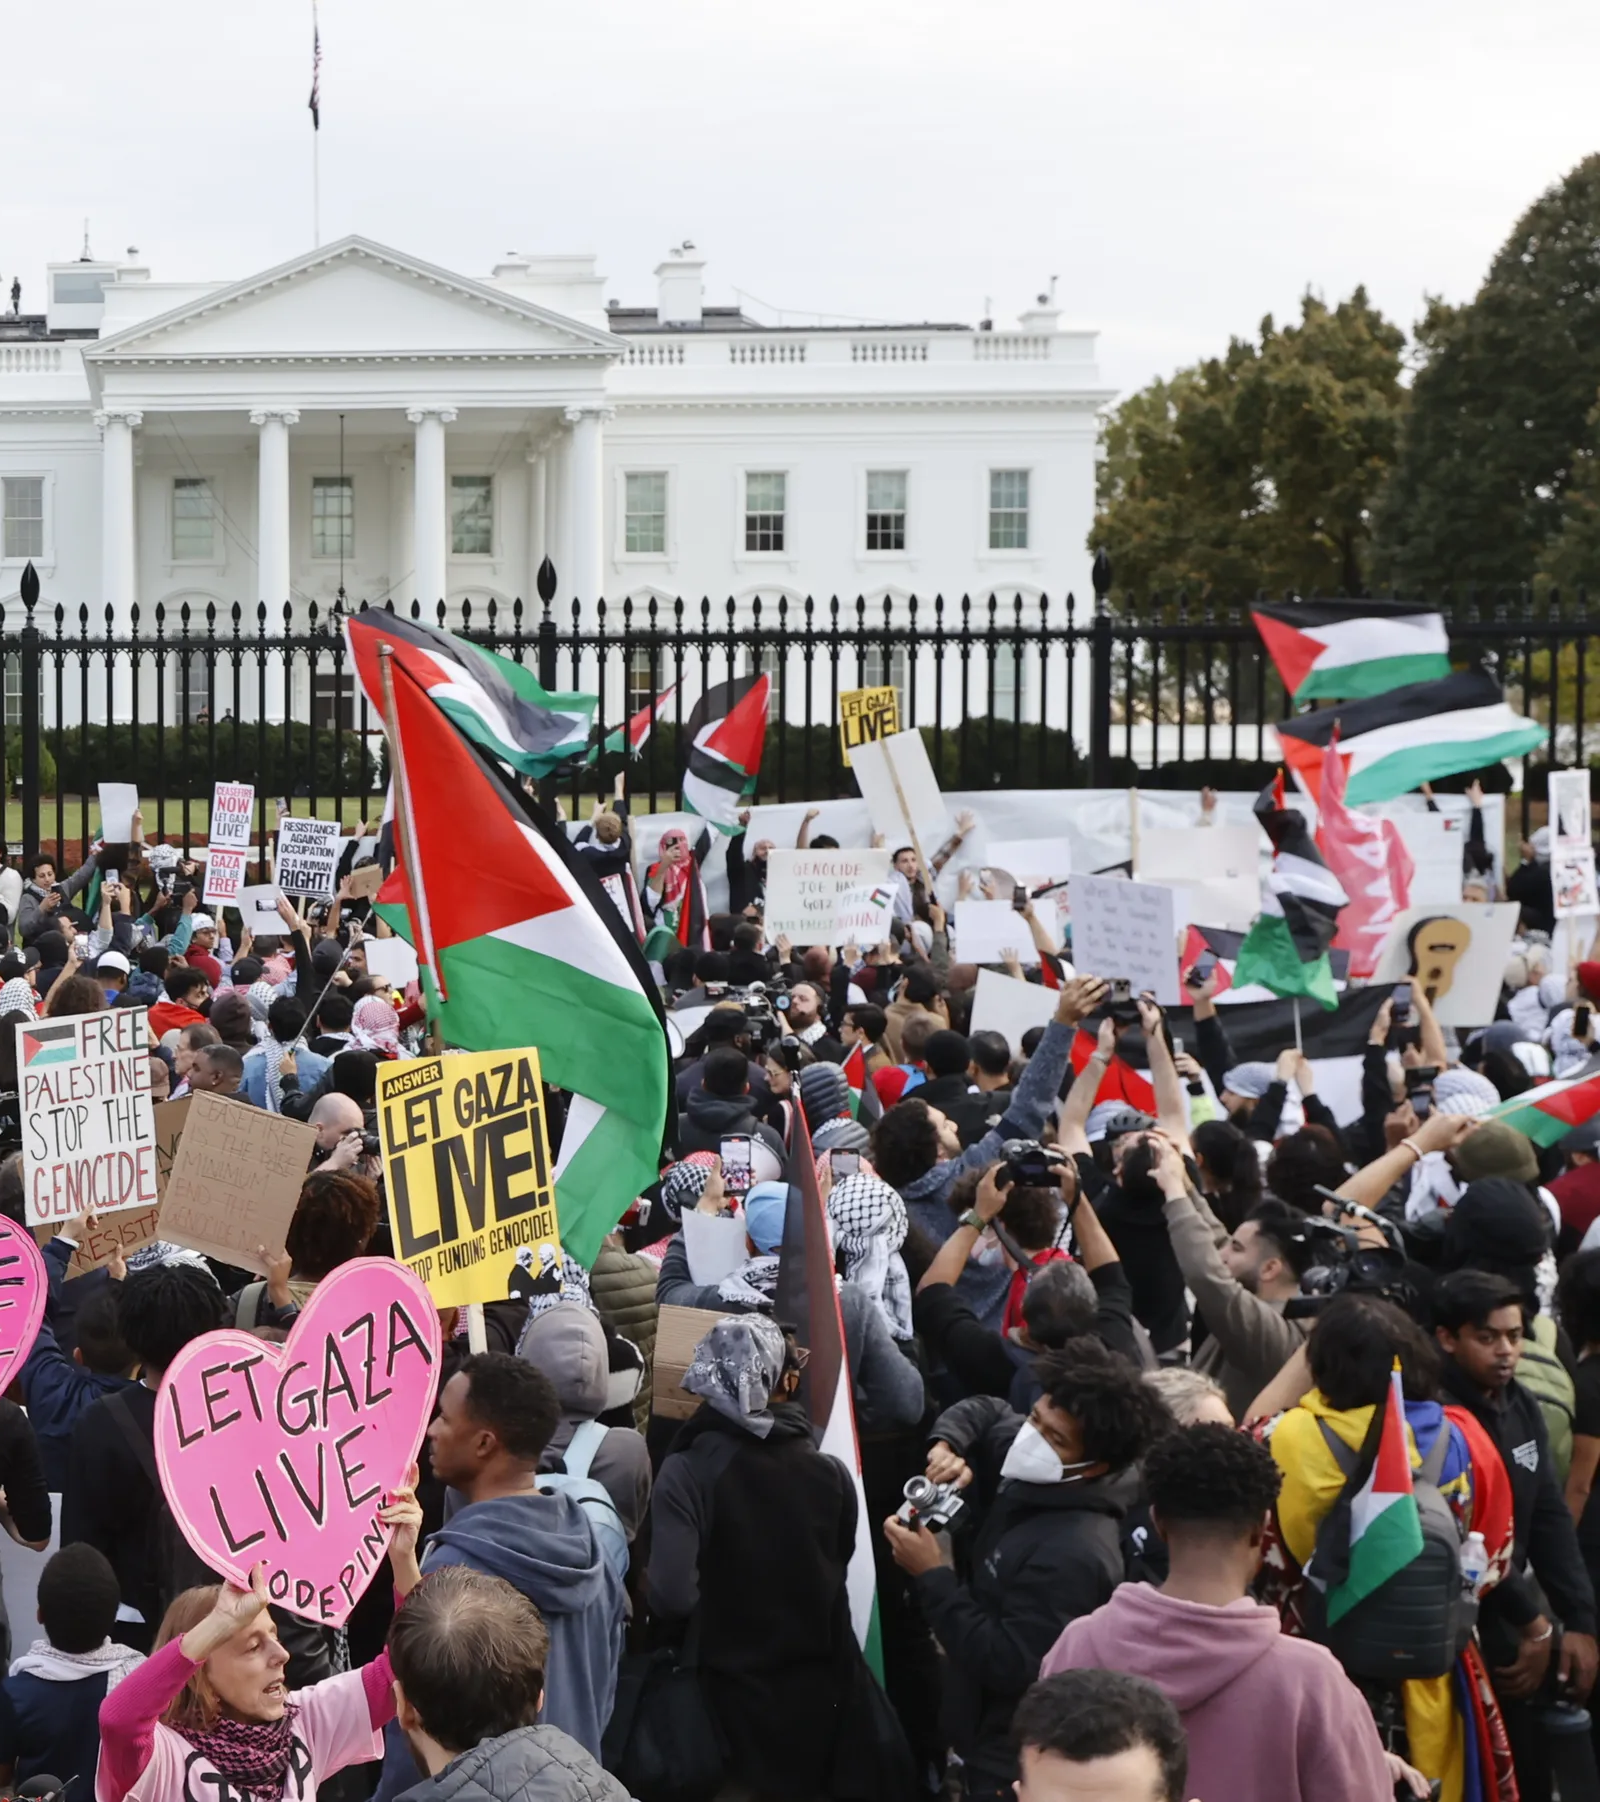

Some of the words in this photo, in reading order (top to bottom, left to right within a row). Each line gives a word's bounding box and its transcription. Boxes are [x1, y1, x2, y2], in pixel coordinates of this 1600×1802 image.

[841, 700, 861, 719] LET
[866, 690, 894, 711] GAZA
[216, 786, 253, 799] CEASEFIRE
[217, 796, 249, 814] NOW
[215, 812, 228, 822] LET
[229, 813, 249, 824] GAZA
[216, 823, 244, 838] LIVE!
[284, 821, 336, 835] RESISTANCE
[280, 844, 335, 858] OCCUPATION
[290, 833, 328, 846] AGAINST
[211, 855, 240, 869] GAZA
[211, 868, 226, 877] WILL
[230, 870, 239, 879] BE
[281, 858, 289, 868] IS
[291, 859, 297, 868] A
[300, 860, 332, 872] HUMAN
[793, 862, 864, 877] GENOCIDE
[208, 877, 239, 893] FREE
[279, 869, 330, 890] RIGHT!
[799, 881, 825, 894] JOE
[82, 1008, 148, 1058] FREE
[25, 1055, 151, 1111] PALESTINE
[384, 1063, 441, 1099] ANSWER
[384, 1087, 442, 1156] LET
[454, 1057, 539, 1128] GAZA
[29, 1105, 88, 1161] STOP
[103, 1094, 148, 1144] THE
[197, 1099, 299, 1149] CEASEFIRE
[189, 1123, 208, 1147] IS
[221, 1132, 253, 1162] THE
[34, 1146, 156, 1218] GENOCIDE
[182, 1151, 270, 1196] MINIMUM
[389, 1106, 550, 1260] LIVE!
[174, 1177, 211, 1206] END
[224, 1192, 257, 1219] THE
[165, 1204, 233, 1242] GENOCIDE
[437, 1234, 486, 1276] FUNDING
[489, 1210, 554, 1255] GENOCIDE!
[169, 1354, 264, 1449] LET
[276, 1301, 432, 1436] GAZA
[210, 1425, 381, 1554] LIVE
